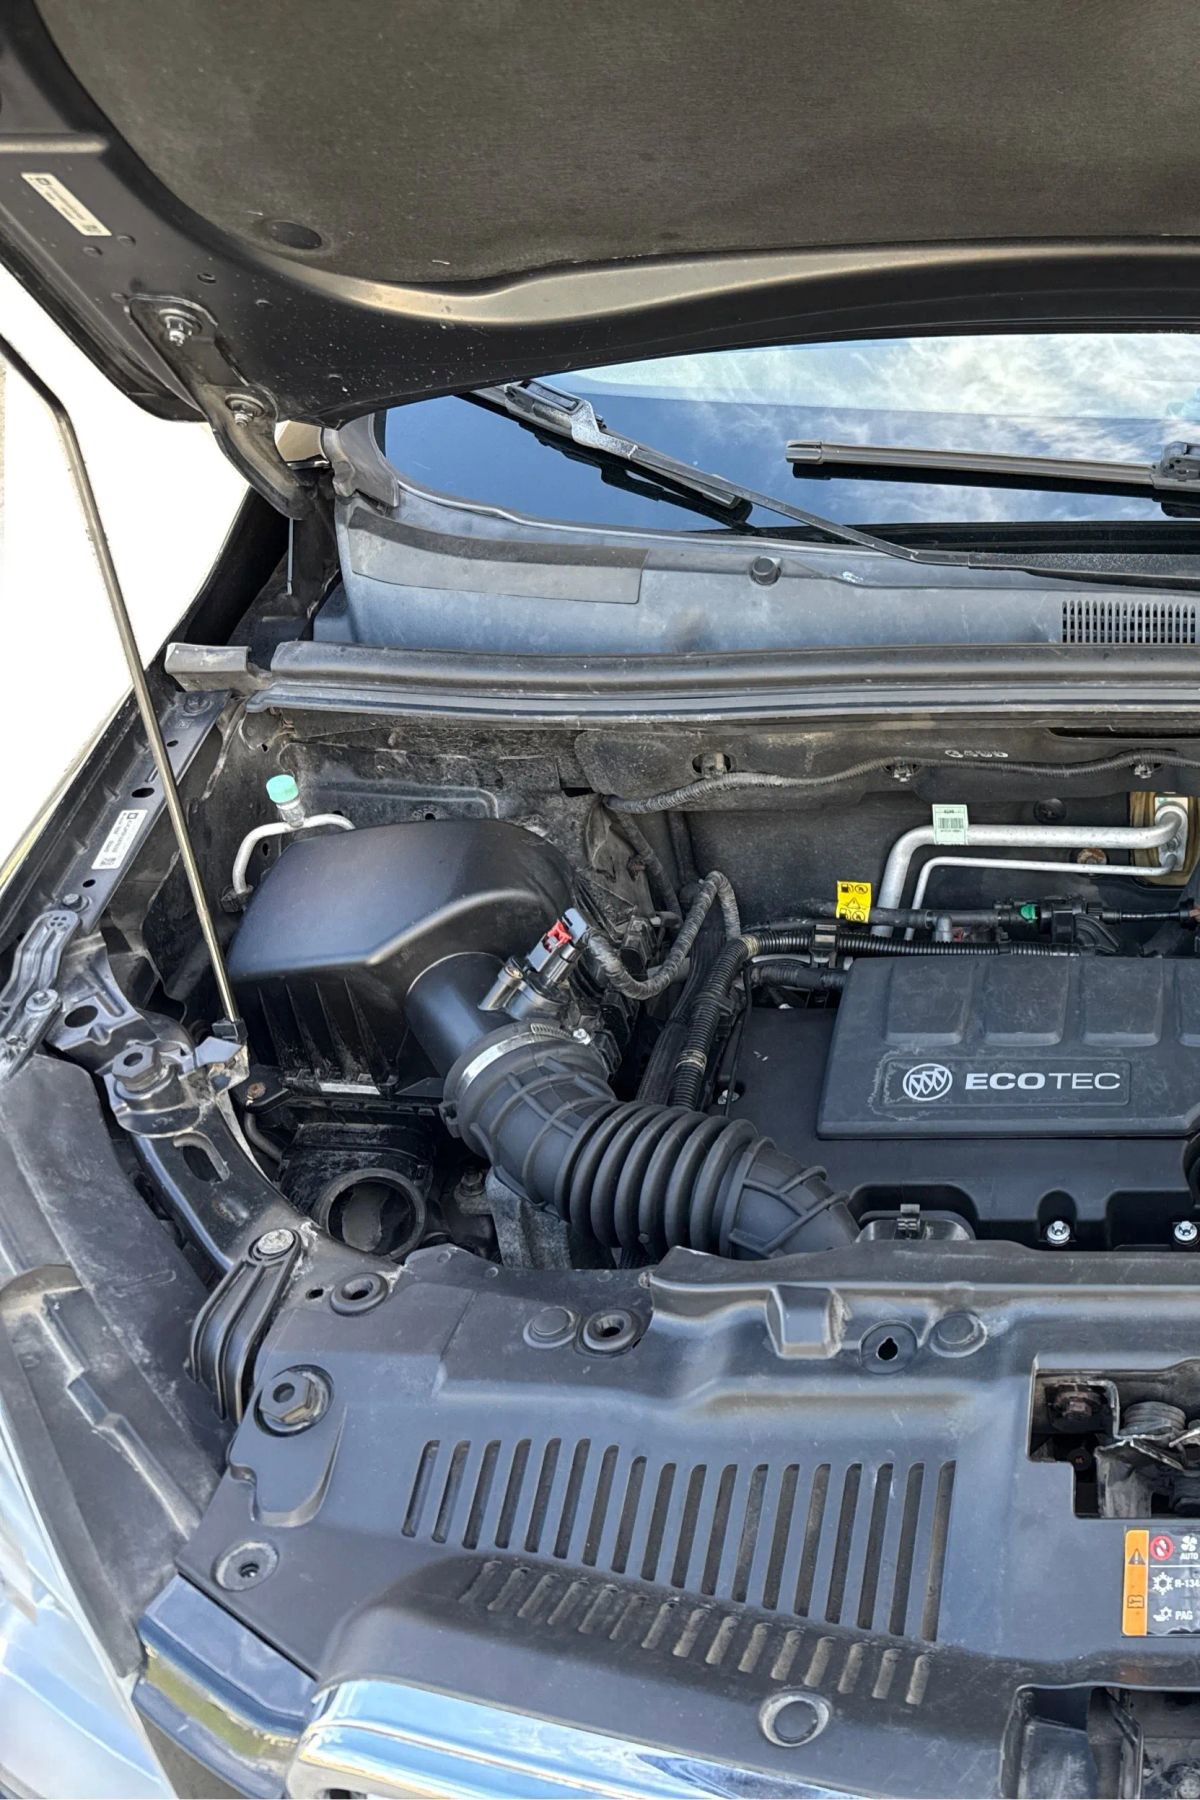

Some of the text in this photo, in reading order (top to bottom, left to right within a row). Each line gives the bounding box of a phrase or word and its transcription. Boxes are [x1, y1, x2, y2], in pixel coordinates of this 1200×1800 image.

[965, 1072, 1121, 1090] ECOTEC
[1180, 1552, 1199, 1560] AUTO
[1175, 1611, 1193, 1620] PAG
